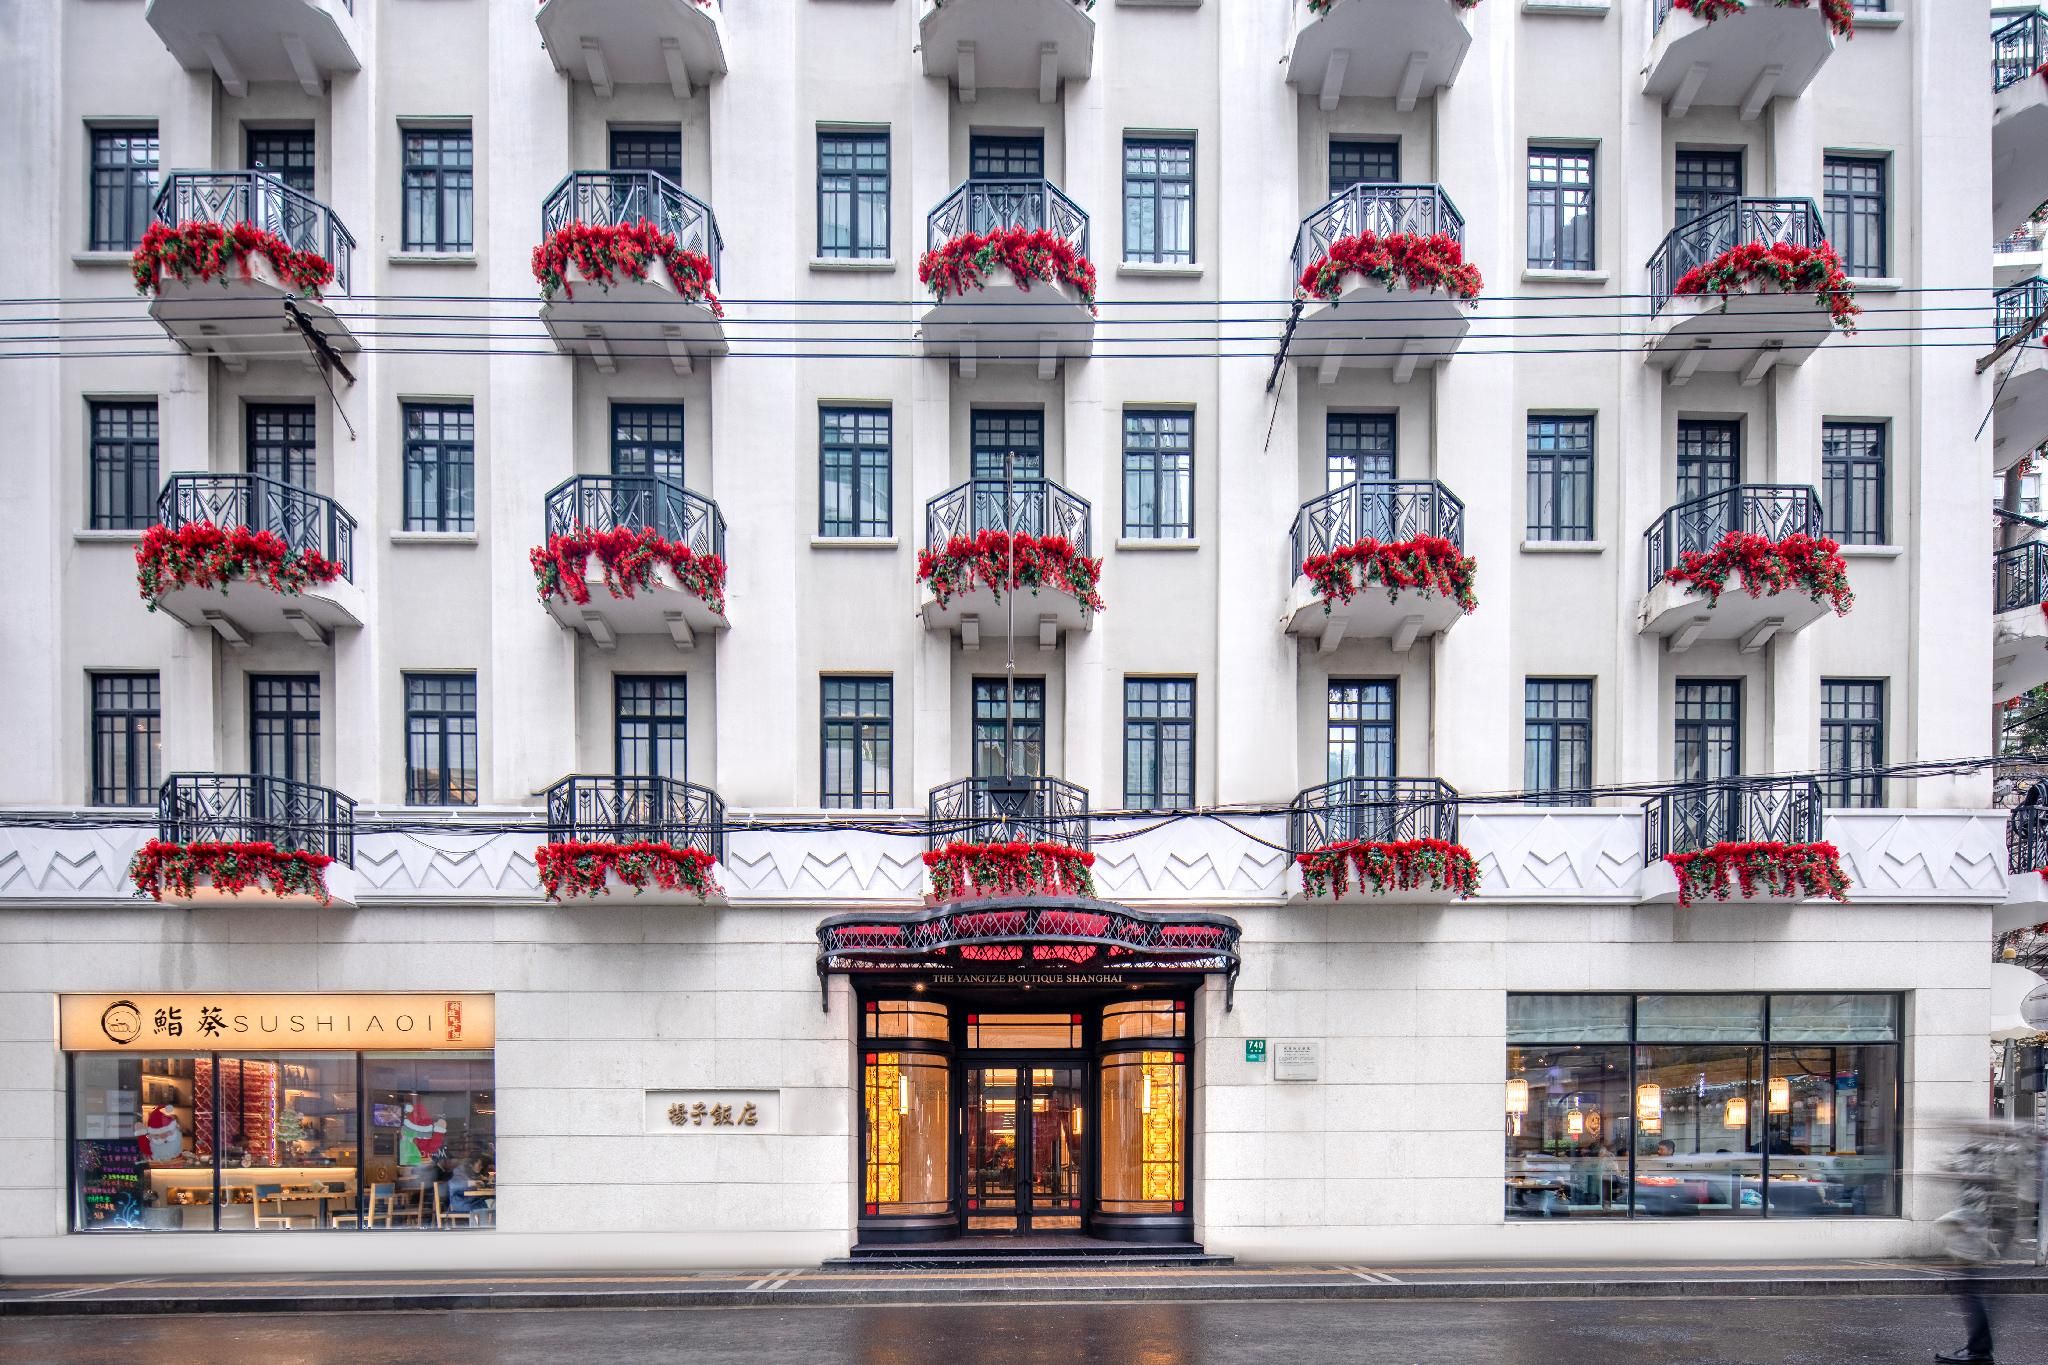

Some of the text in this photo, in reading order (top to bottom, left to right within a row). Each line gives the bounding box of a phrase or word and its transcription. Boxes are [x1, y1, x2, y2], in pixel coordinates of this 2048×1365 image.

[933, 974, 1122, 984] THE YANGTZE BOUTIQUE SHANGHAI
[233, 1015, 432, 1032] SUSHIAOI
[1249, 1041, 1263, 1049] 740
